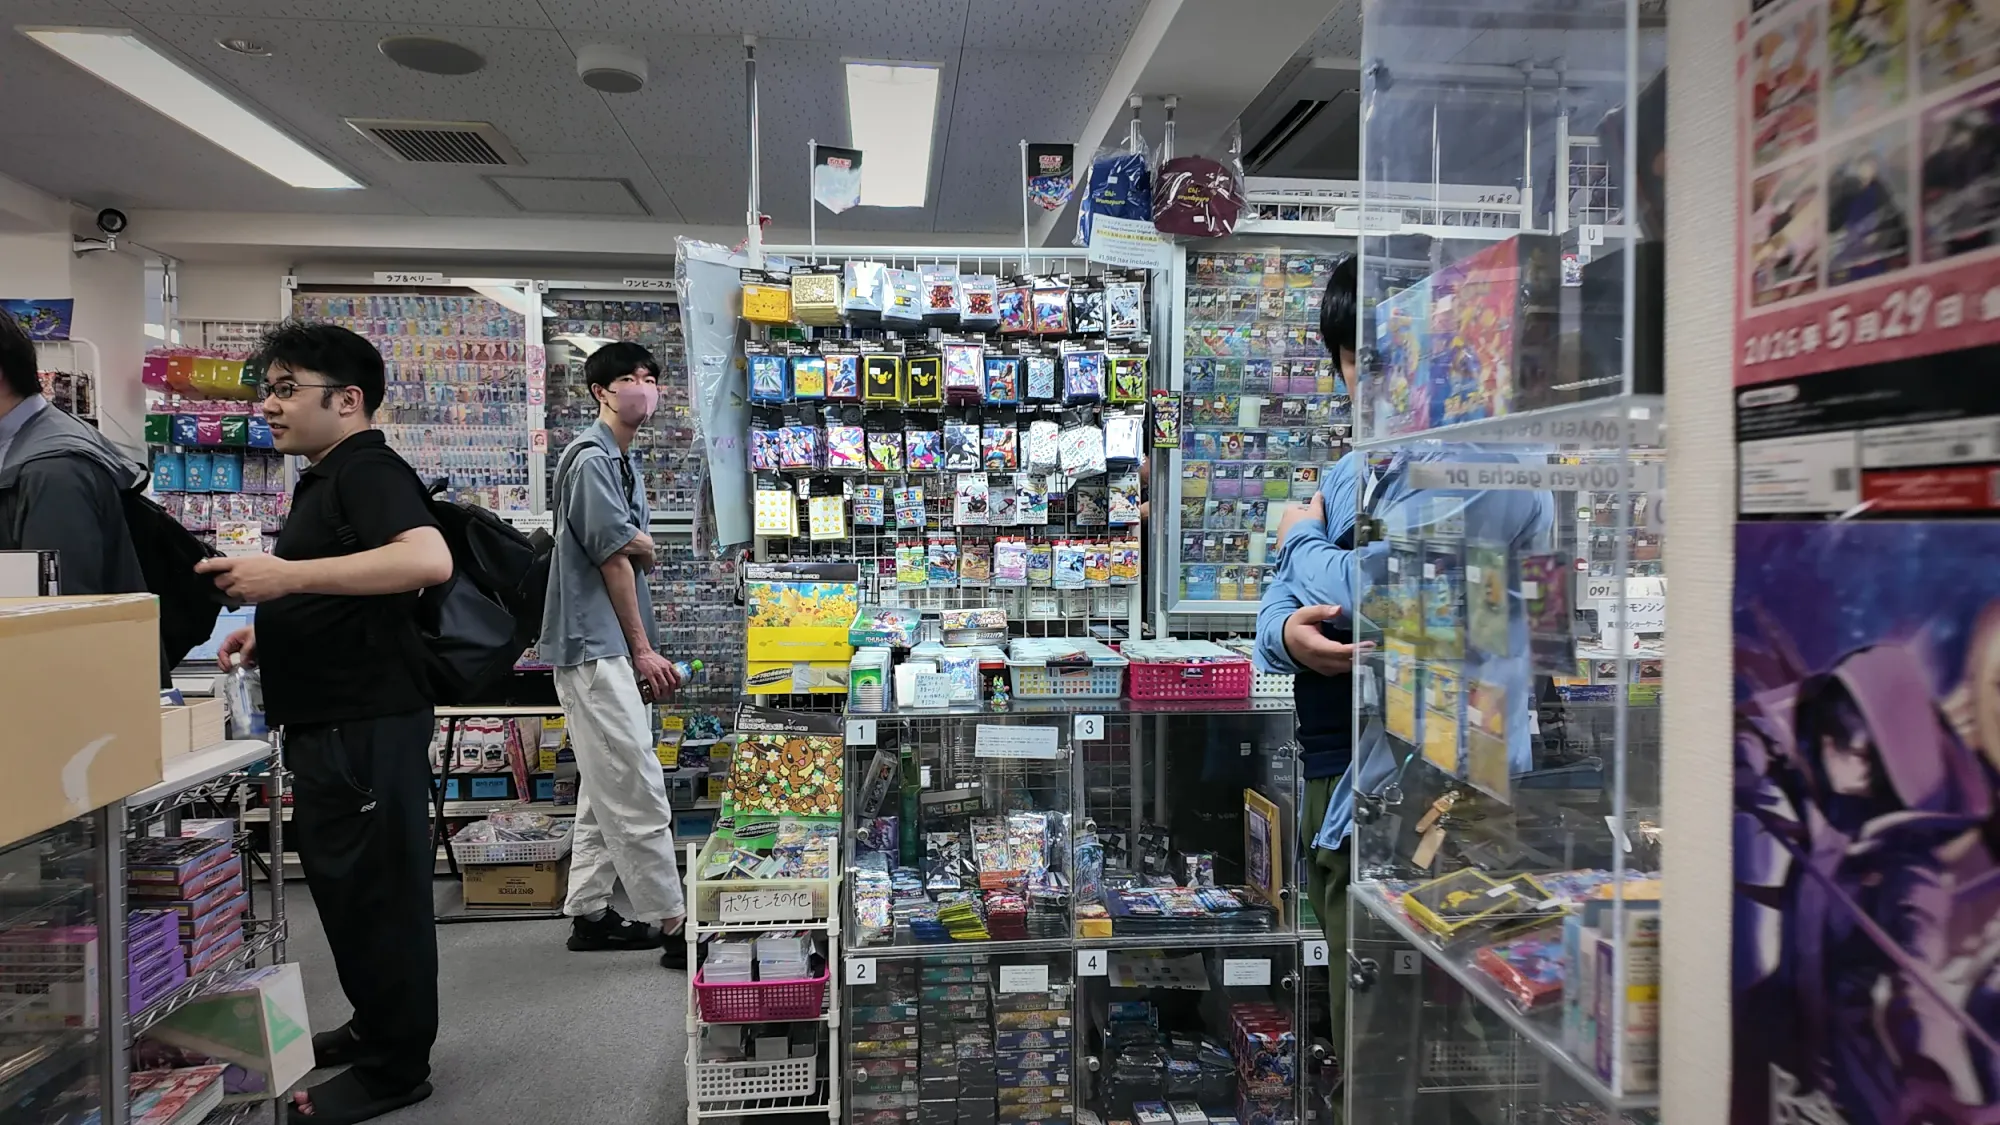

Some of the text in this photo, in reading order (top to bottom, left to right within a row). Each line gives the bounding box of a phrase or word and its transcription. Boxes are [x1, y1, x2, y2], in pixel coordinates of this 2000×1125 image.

[1588, 229, 1596, 240] U
[1129, 257, 1160, 267] included)
[285, 277, 293, 286] A
[537, 281, 544, 291] C
[1589, 586, 1611, 596] 091
[858, 724, 864, 740] 1
[1085, 720, 1094, 735] 3
[724, 892, 811, 913] ポケモンその他
[1313, 946, 1322, 960] 6
[1087, 955, 1098, 970] 4
[856, 963, 866, 979] 2
